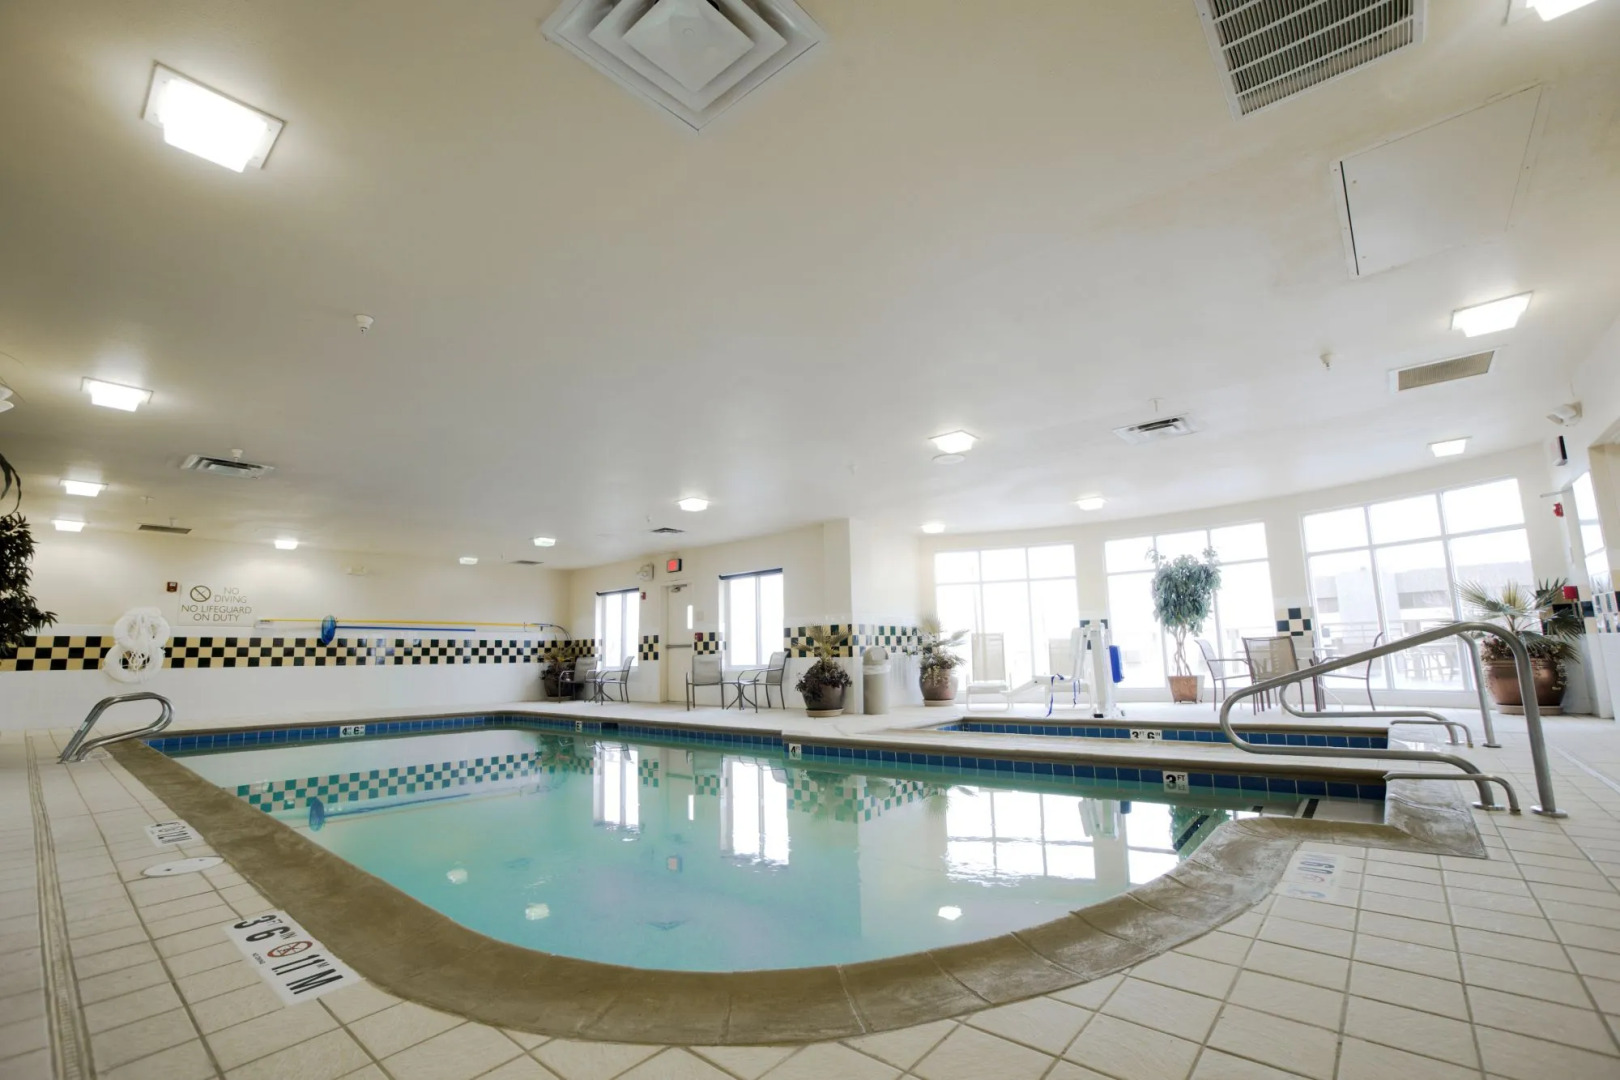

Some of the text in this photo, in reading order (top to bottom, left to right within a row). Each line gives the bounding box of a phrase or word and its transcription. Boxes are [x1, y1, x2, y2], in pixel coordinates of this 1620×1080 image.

[224, 587, 240, 595] NO
[214, 595, 247, 603] DIVING
[201, 605, 252, 614] LIFEGUARD
[193, 613, 240, 622] ON DUTY
[1165, 774, 1177, 787] 3
[234, 915, 277, 929] 3
[245, 926, 290, 942] 6
[286, 968, 344, 995] M
